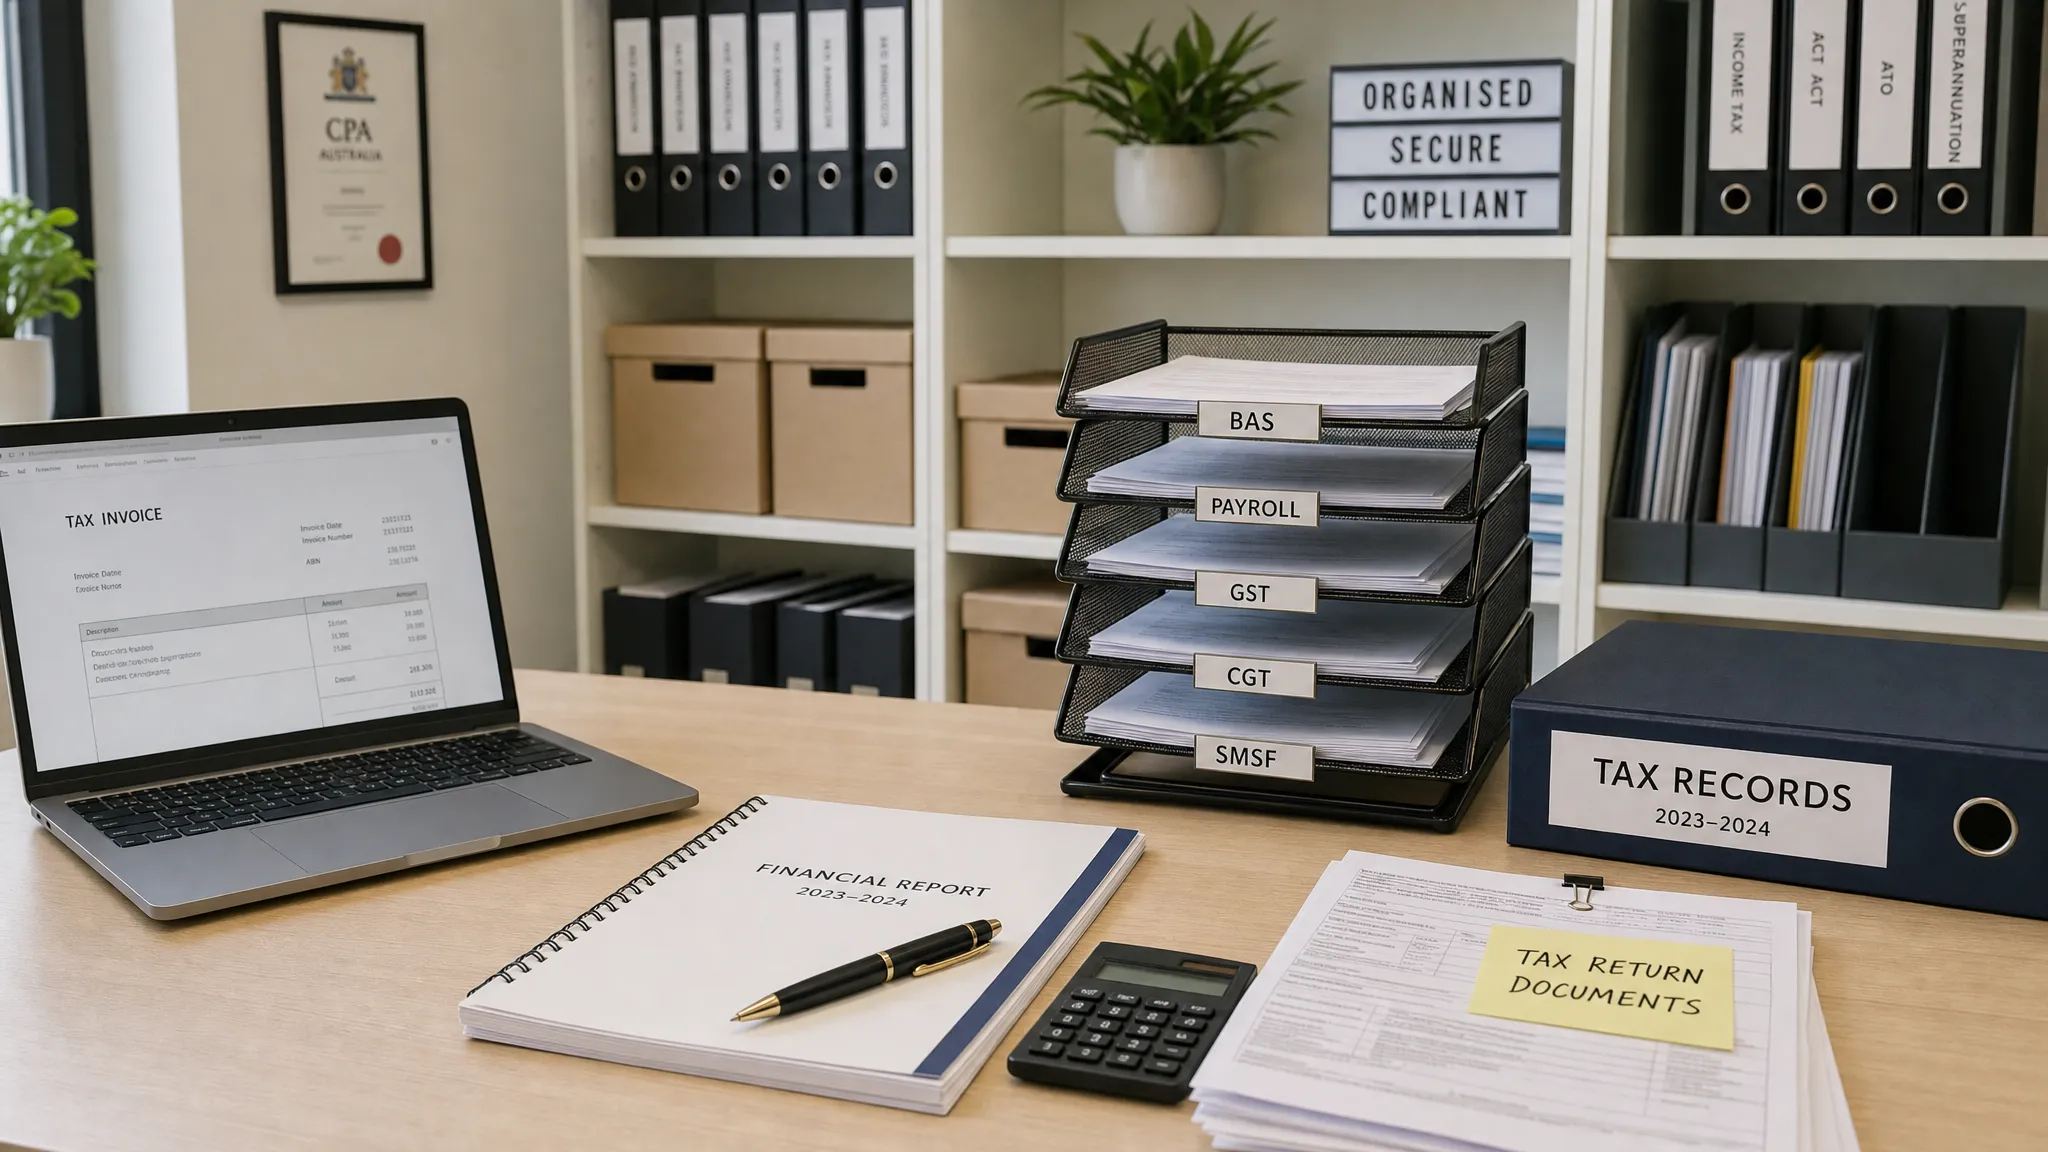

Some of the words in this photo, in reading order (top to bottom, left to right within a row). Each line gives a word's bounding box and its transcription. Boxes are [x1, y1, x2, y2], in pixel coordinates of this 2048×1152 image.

[1812, 31, 1824, 64] ACT
[1731, 32, 1745, 98] INCOME
[1880, 61, 1894, 96] ATO
[1363, 79, 1532, 110] ORGANISED
[1810, 74, 1823, 107] ACT
[1948, 2, 1967, 164] SUPERANNUATION
[325, 117, 373, 143] CPA
[1730, 103, 1743, 135] TAX
[1390, 134, 1502, 163] SECURE
[1363, 190, 1527, 219] COMPLIANT
[1230, 411, 1275, 431] BAS
[65, 513, 95, 528] TAX
[101, 507, 163, 525] INVOICE
[1212, 498, 1301, 518] PAYROLL
[1230, 583, 1270, 603] GST
[1227, 667, 1271, 687] CGT
[1216, 745, 1277, 768] SMSF
[1593, 757, 1659, 791] TAX
[1674, 767, 1852, 813] RECORDS
[756, 863, 887, 887] FINANCIAL
[895, 879, 991, 898] REPORT
[1517, 949, 1572, 970] TAX
[1588, 956, 1704, 984] RETURN
[1509, 975, 1702, 1015] DOCUMENTS
